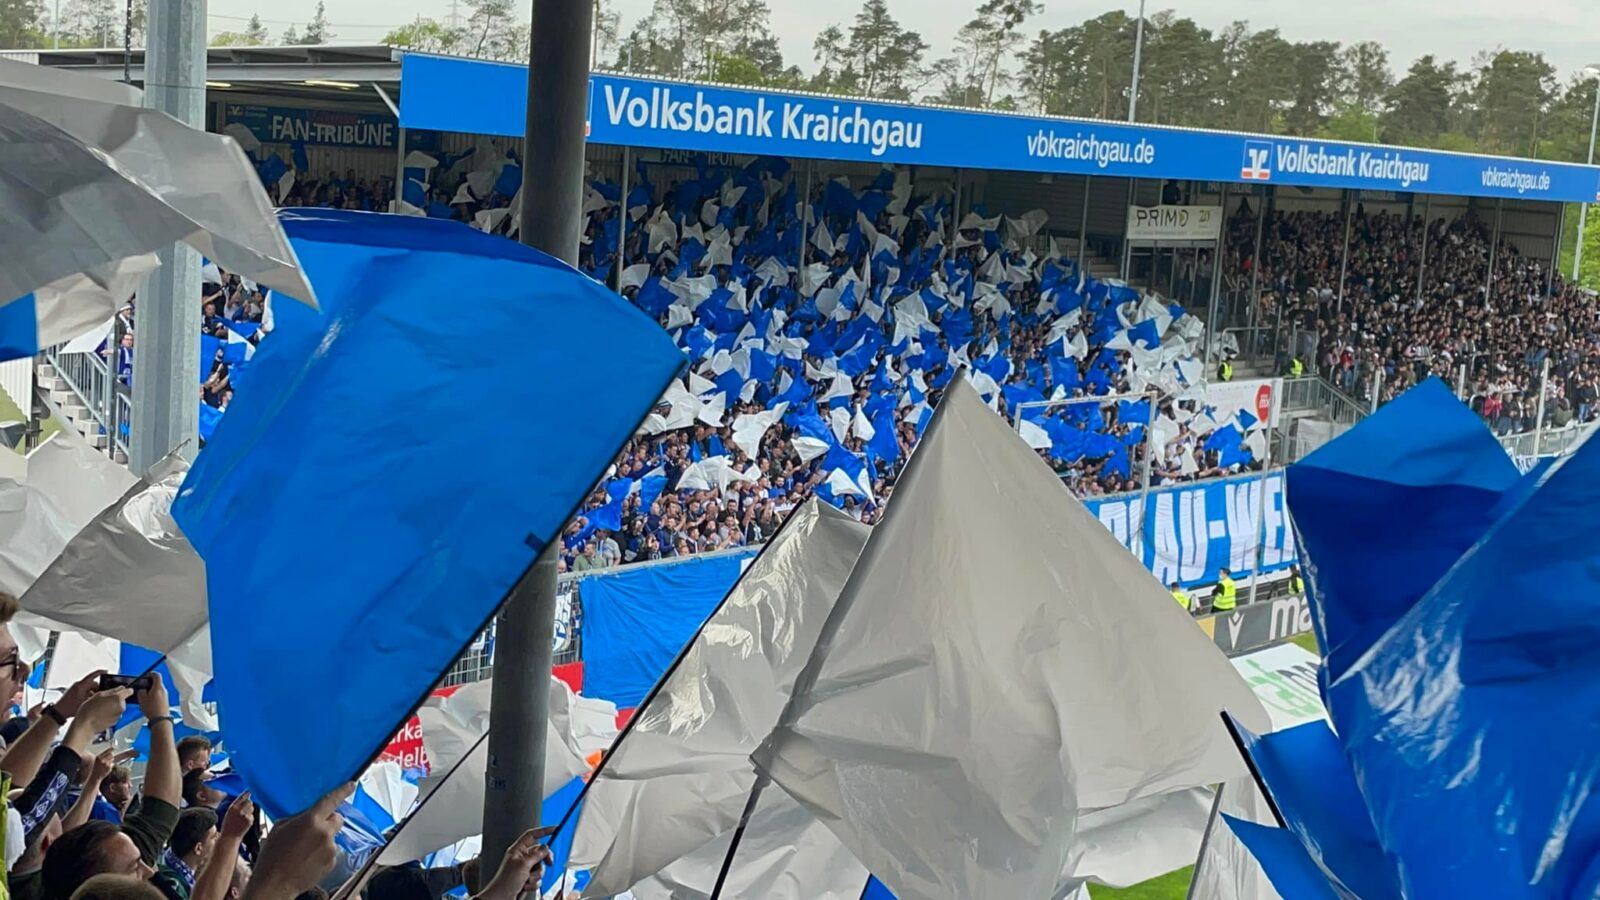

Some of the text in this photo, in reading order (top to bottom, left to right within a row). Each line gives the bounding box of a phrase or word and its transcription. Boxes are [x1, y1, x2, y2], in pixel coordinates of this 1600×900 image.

[271, 115, 393, 146] FAN-TRIBÜNE
[604, 84, 923, 156] Volksbank Kraichgau
[1027, 129, 1155, 168] vbkraichgau.de
[1277, 145, 1430, 188] Volksbank Kraichgau
[1481, 165, 1551, 194] vbkraichgau.de
